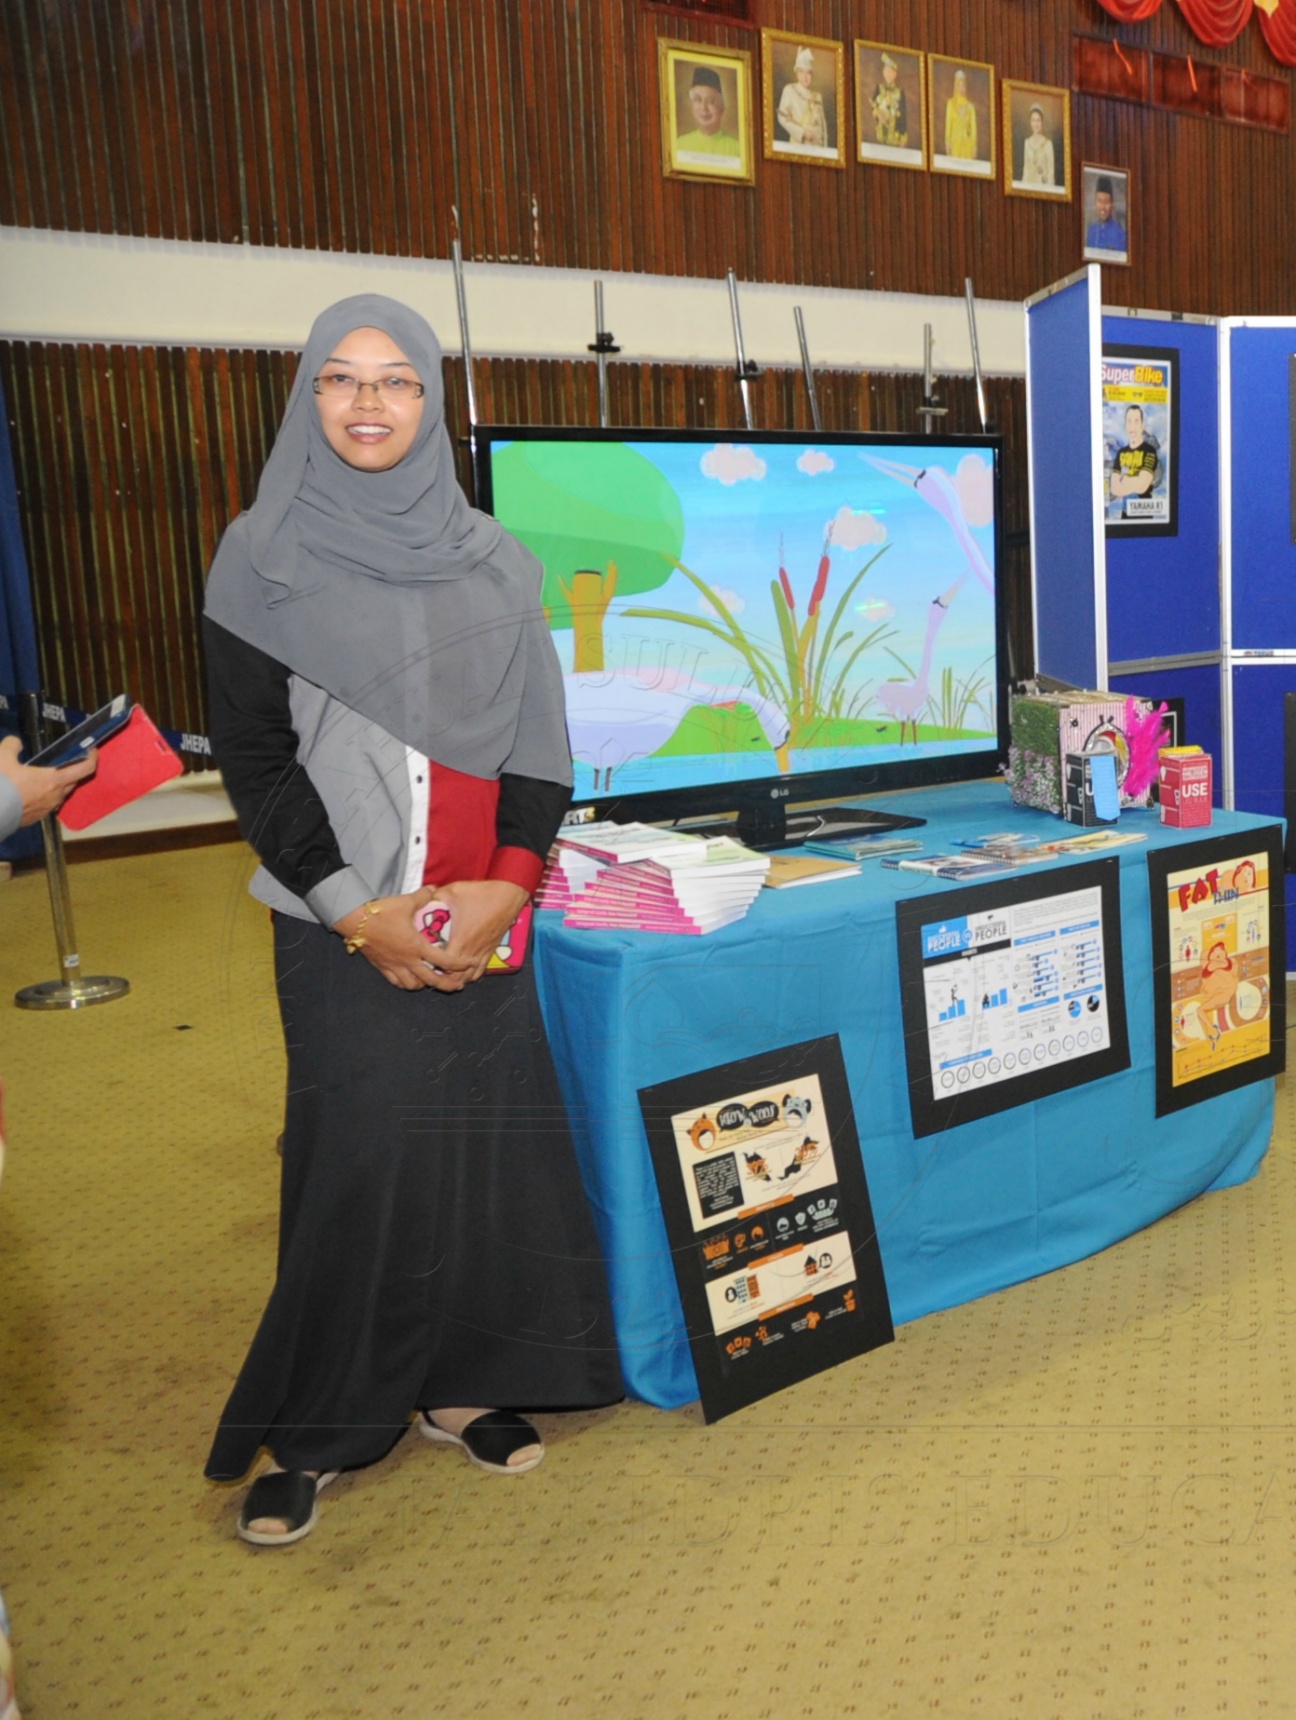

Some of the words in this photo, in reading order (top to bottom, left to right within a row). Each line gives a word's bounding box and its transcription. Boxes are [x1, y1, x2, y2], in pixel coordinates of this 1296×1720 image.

[1129, 502, 1155, 511] YAMAHA
[180, 733, 212, 756] JHEPA
[780, 789, 789, 797] LG
[1182, 782, 1208, 798] USE
[1178, 868, 1218, 912] FAT
[975, 924, 1007, 941] PEOPLE
[927, 933, 961, 953] PEOPLE
